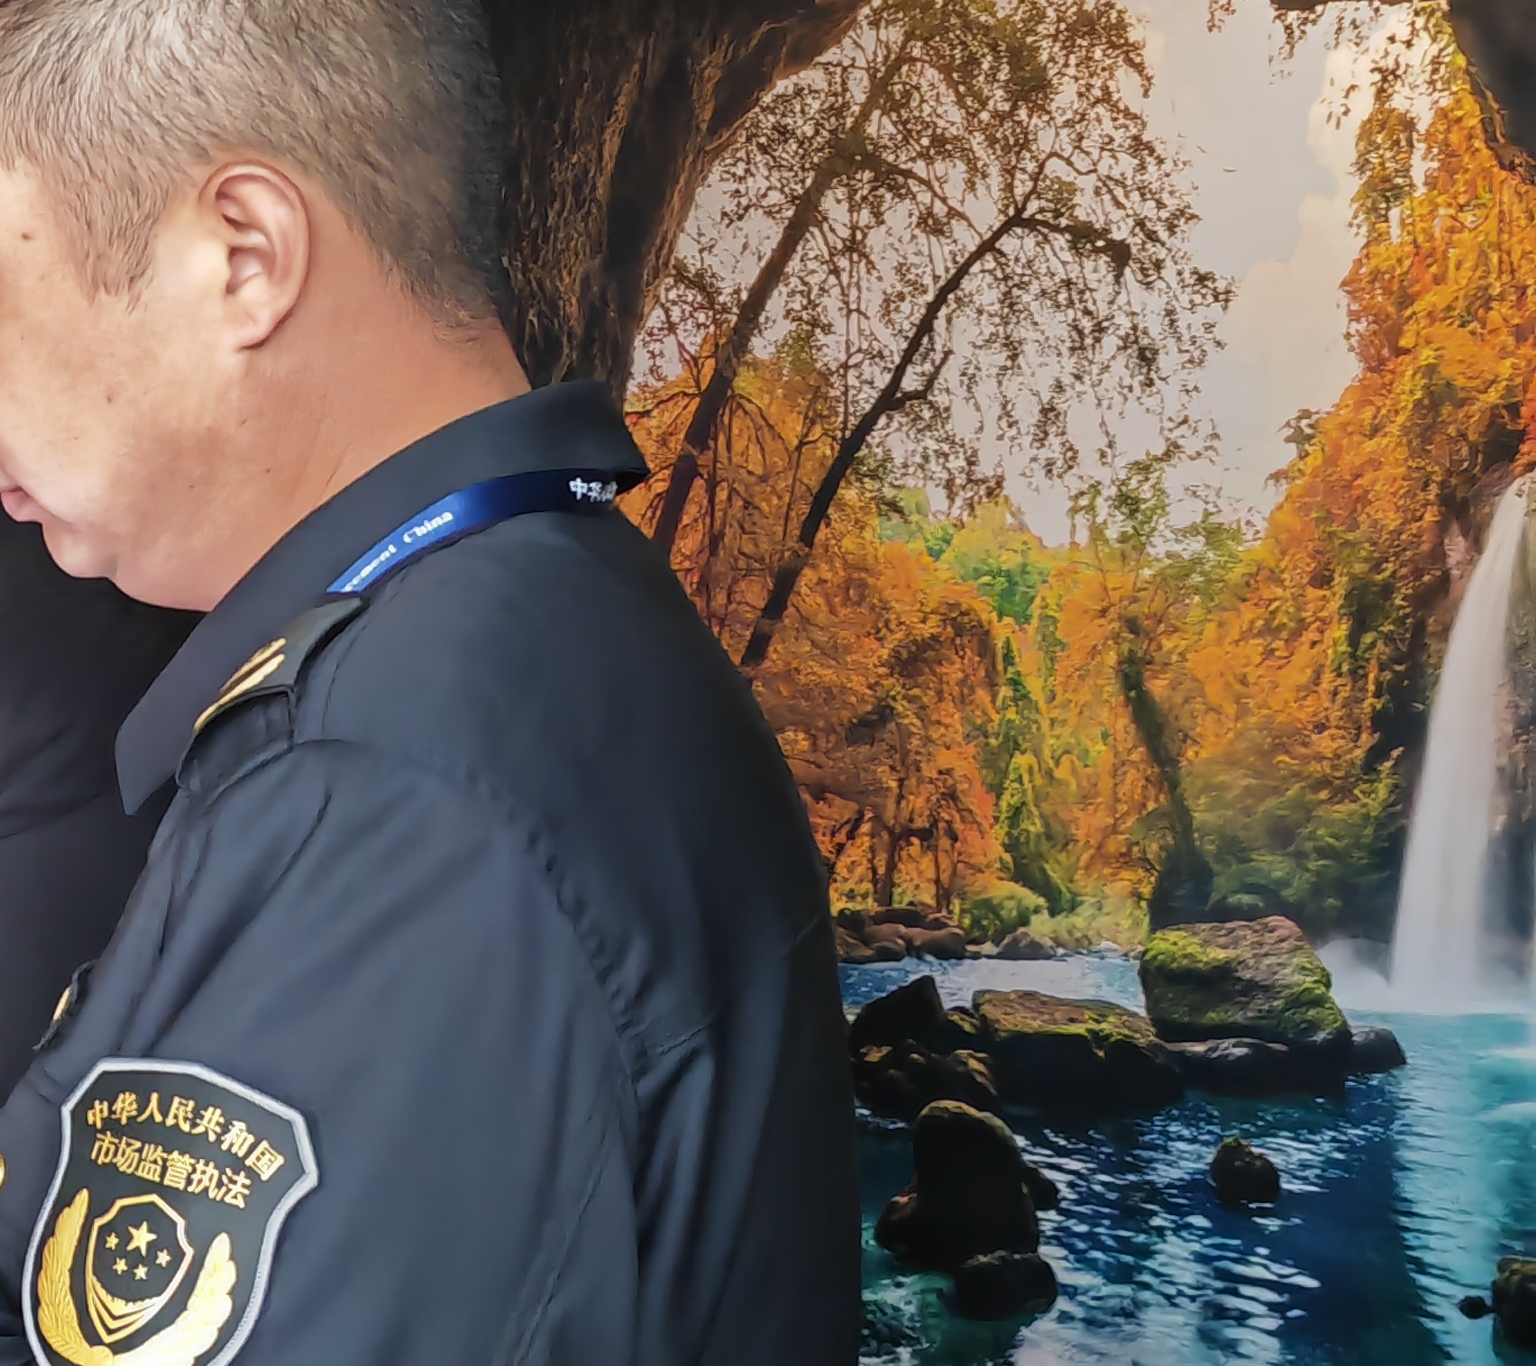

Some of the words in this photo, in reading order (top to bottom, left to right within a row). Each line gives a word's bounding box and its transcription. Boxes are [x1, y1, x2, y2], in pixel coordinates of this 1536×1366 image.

[402, 511, 454, 544] China
[86, 1091, 286, 1181] 中华人民共和国
[90, 1131, 252, 1209] 市场监管执法
